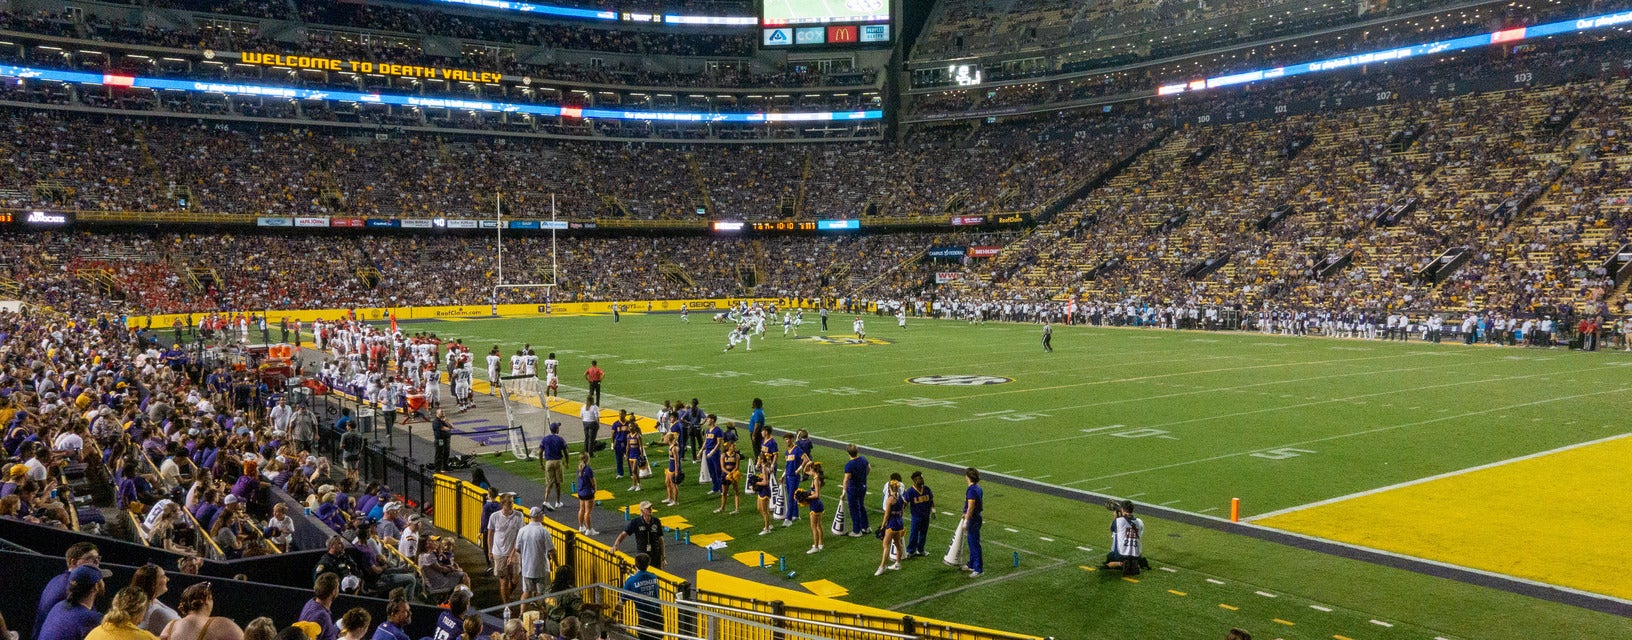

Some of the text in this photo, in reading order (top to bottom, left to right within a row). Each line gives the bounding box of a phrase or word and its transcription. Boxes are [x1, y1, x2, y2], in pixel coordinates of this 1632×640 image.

[1576, 10, 1632, 28] Our playboo
[797, 31, 823, 40] COX
[242, 52, 502, 83] WELCOME TO DEATH VALLEY
[1322, 58, 1350, 70] playbook
[1514, 72, 1533, 83] 103
[194, 82, 208, 90] Our
[208, 84, 238, 93] playbook
[1275, 105, 1288, 113] 101
[1198, 115, 1210, 123] 100
[28, 214, 65, 222] ADVOCATE
[433, 218, 445, 227] 40
[429, 374, 440, 382] 54
[914, 494, 930, 504] LSU
[832, 505, 846, 532] LSU
[442, 616, 456, 629] TIGERS
